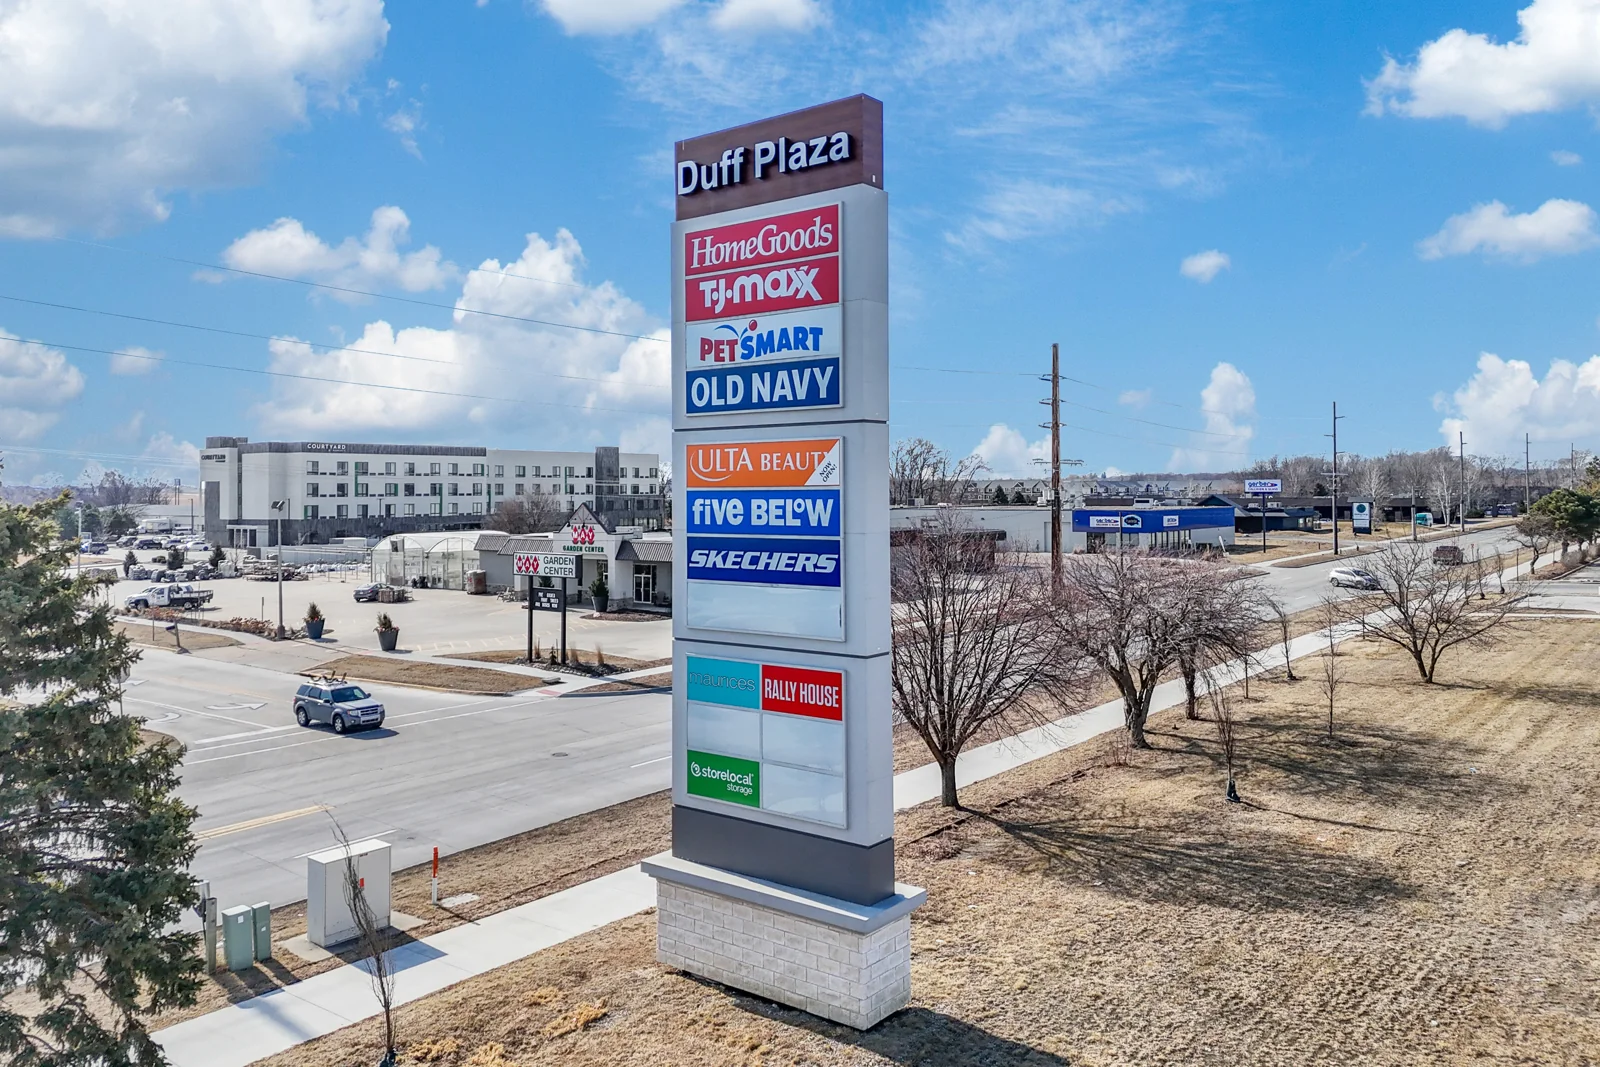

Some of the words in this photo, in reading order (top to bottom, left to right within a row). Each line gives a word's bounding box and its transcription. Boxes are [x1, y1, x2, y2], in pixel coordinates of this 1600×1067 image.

[678, 147, 744, 195] Duff
[755, 132, 850, 179] Plaza
[690, 216, 832, 268] HomeGoods
[700, 326, 823, 362] PETSMART
[691, 374, 744, 407] OLD
[752, 366, 833, 403] NAVY
[698, 447, 753, 472] ULTA
[819, 461, 832, 477] NOW
[822, 464, 837, 483] OPEN!
[692, 498, 744, 525] five
[751, 498, 834, 526] BELOW
[543, 556, 574, 566] GARDEN
[544, 566, 574, 576] CENTER
[689, 550, 838, 573] SKECHERS
[689, 672, 756, 692] maurices
[764, 678, 797, 702] RALLY
[800, 682, 839, 708] HOUSE
[726, 783, 753, 796] storage
